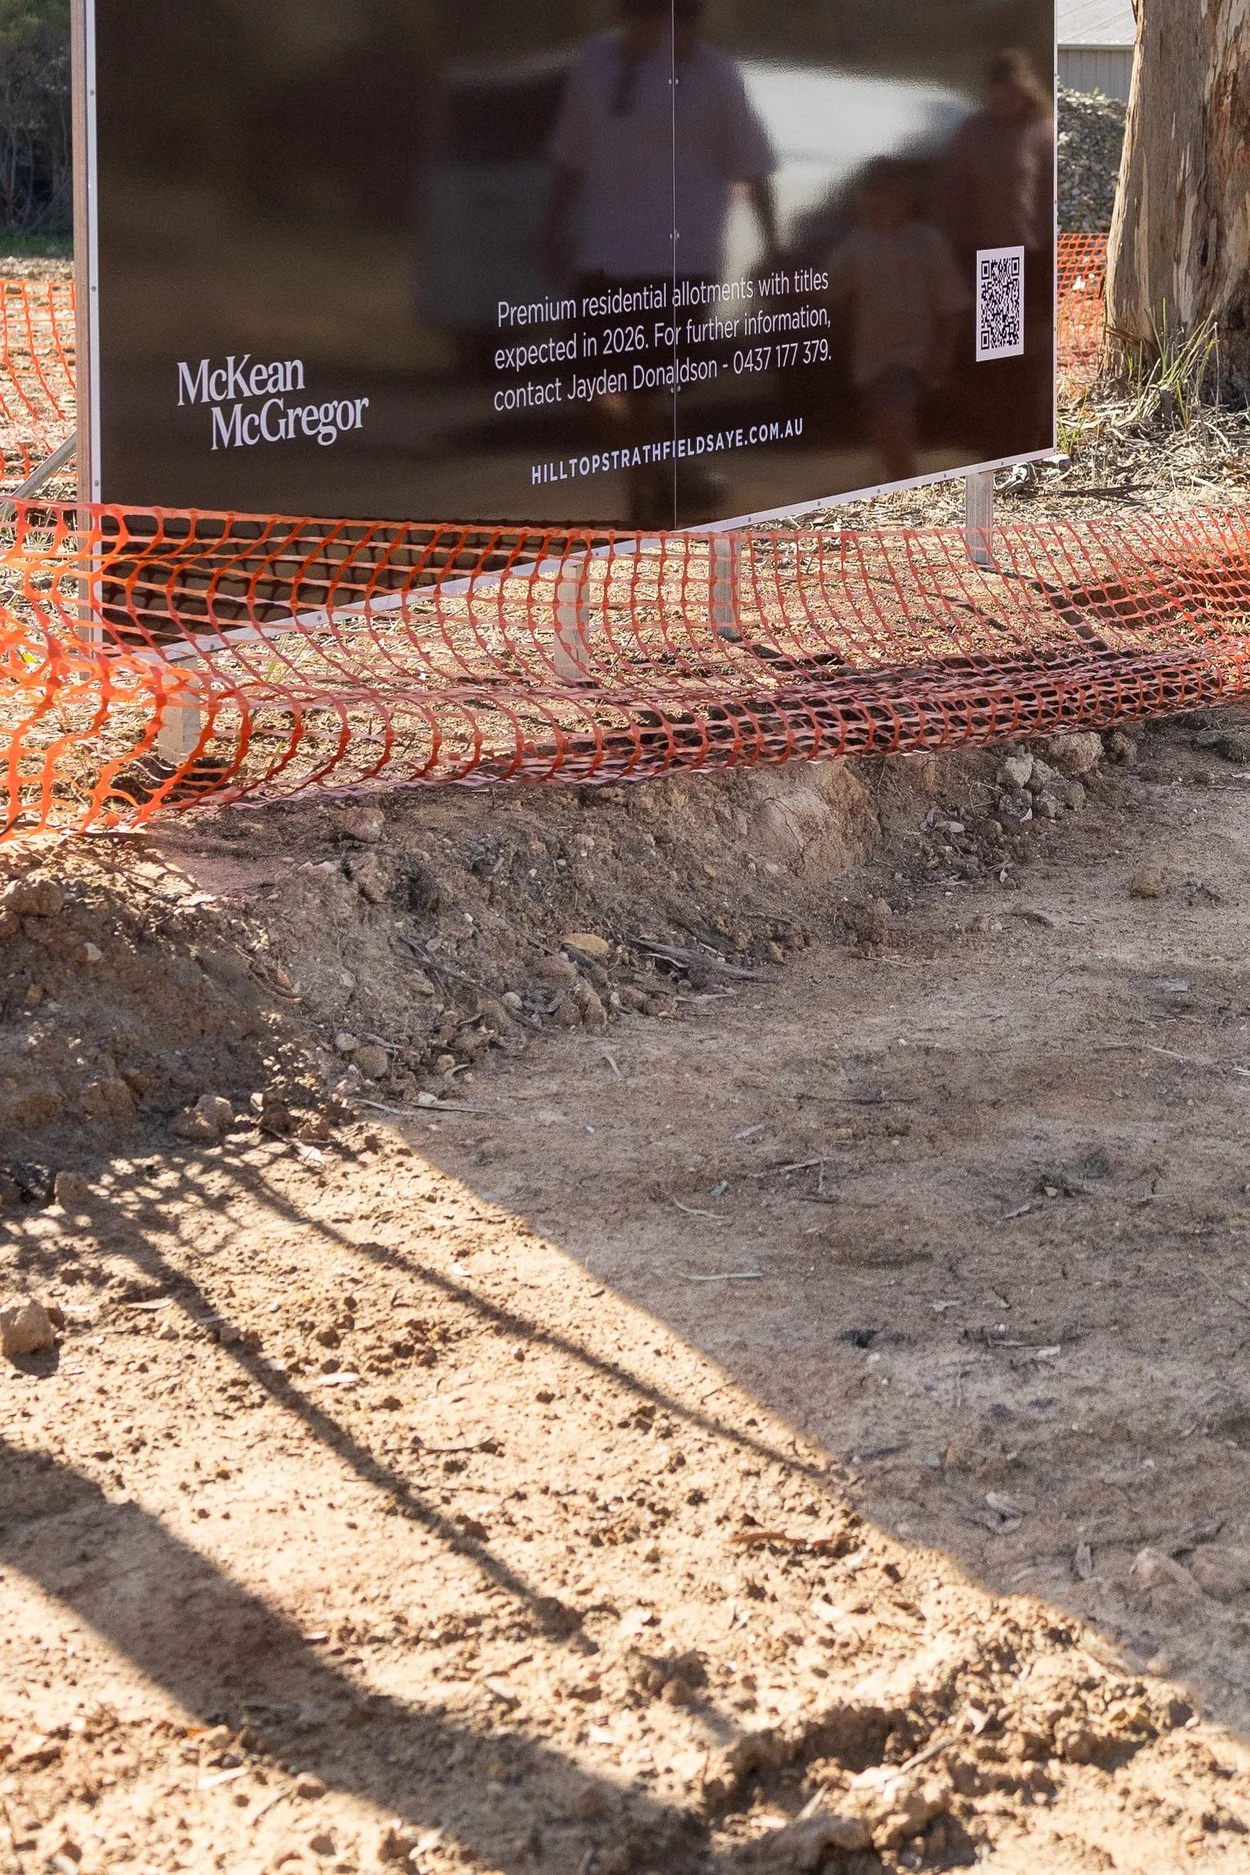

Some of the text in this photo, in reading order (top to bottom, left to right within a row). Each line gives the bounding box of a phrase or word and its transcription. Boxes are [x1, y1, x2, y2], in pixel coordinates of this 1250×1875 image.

[498, 268, 829, 327] Premium residential allotments with titles
[494, 305, 831, 372] expected in 2026. For further information,
[177, 354, 305, 406] McKean
[494, 377, 562, 411] contact
[568, 370, 627, 402] Jayden
[633, 358, 718, 388] Donaldson
[733, 350, 771, 374] 0437
[776, 344, 798, 368] 177
[803, 339, 832, 364] 379.
[211, 398, 369, 450] McGregor
[531, 417, 804, 485] HILLTOPSTRATHFIELDSAYE.COM.AU
